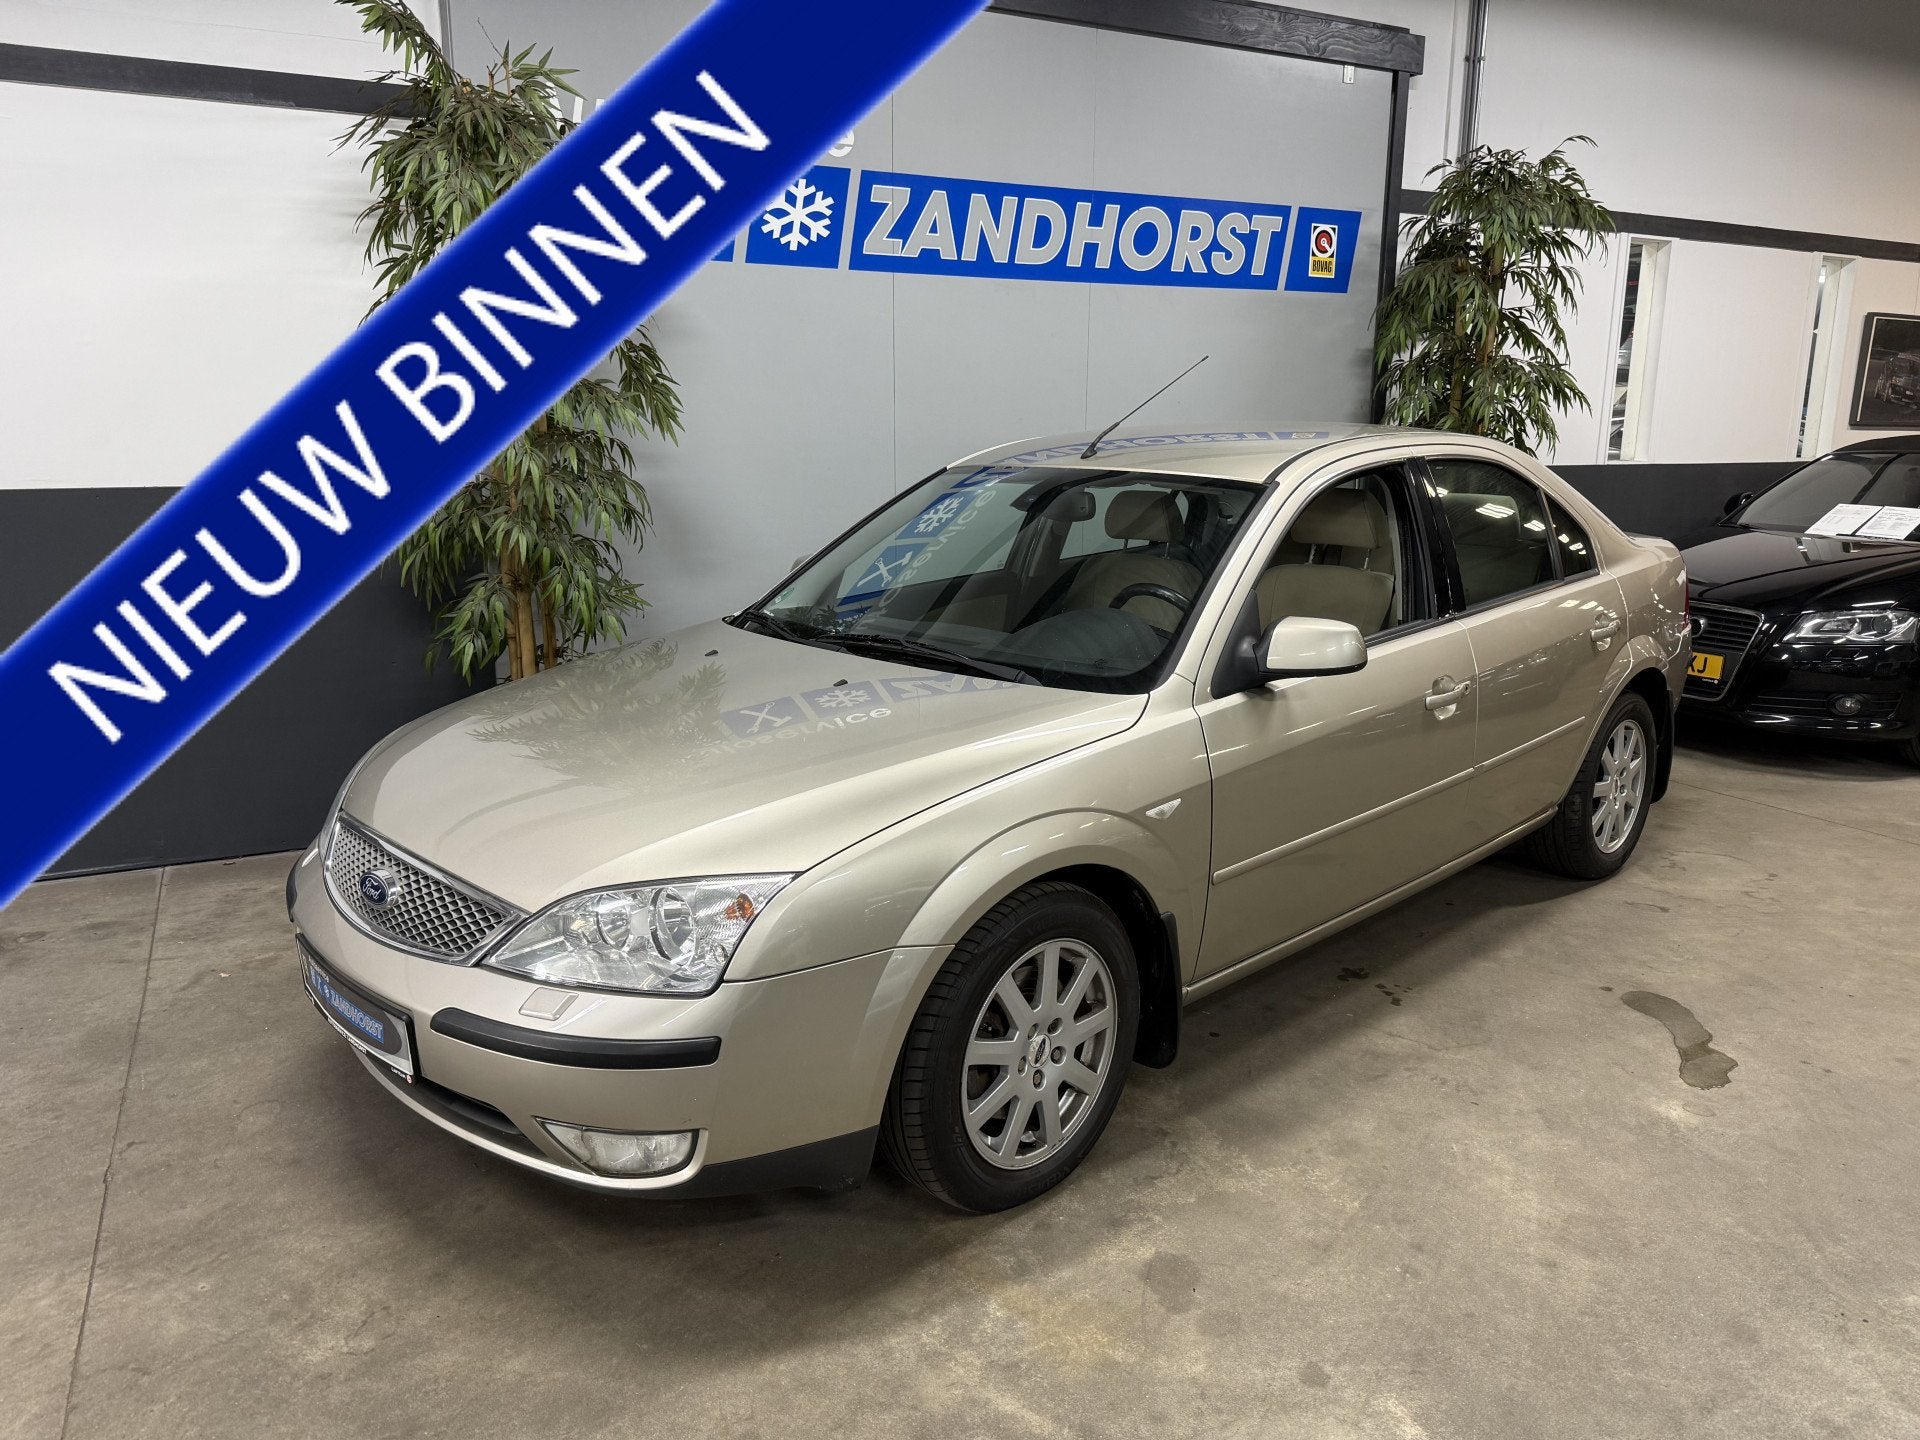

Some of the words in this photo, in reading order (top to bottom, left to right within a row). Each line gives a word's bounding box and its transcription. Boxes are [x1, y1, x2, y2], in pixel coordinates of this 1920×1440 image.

[863, 184, 1283, 276] ZANDHORST
[1311, 259, 1333, 273] BOVAG
[363, 877, 381, 900] Ford
